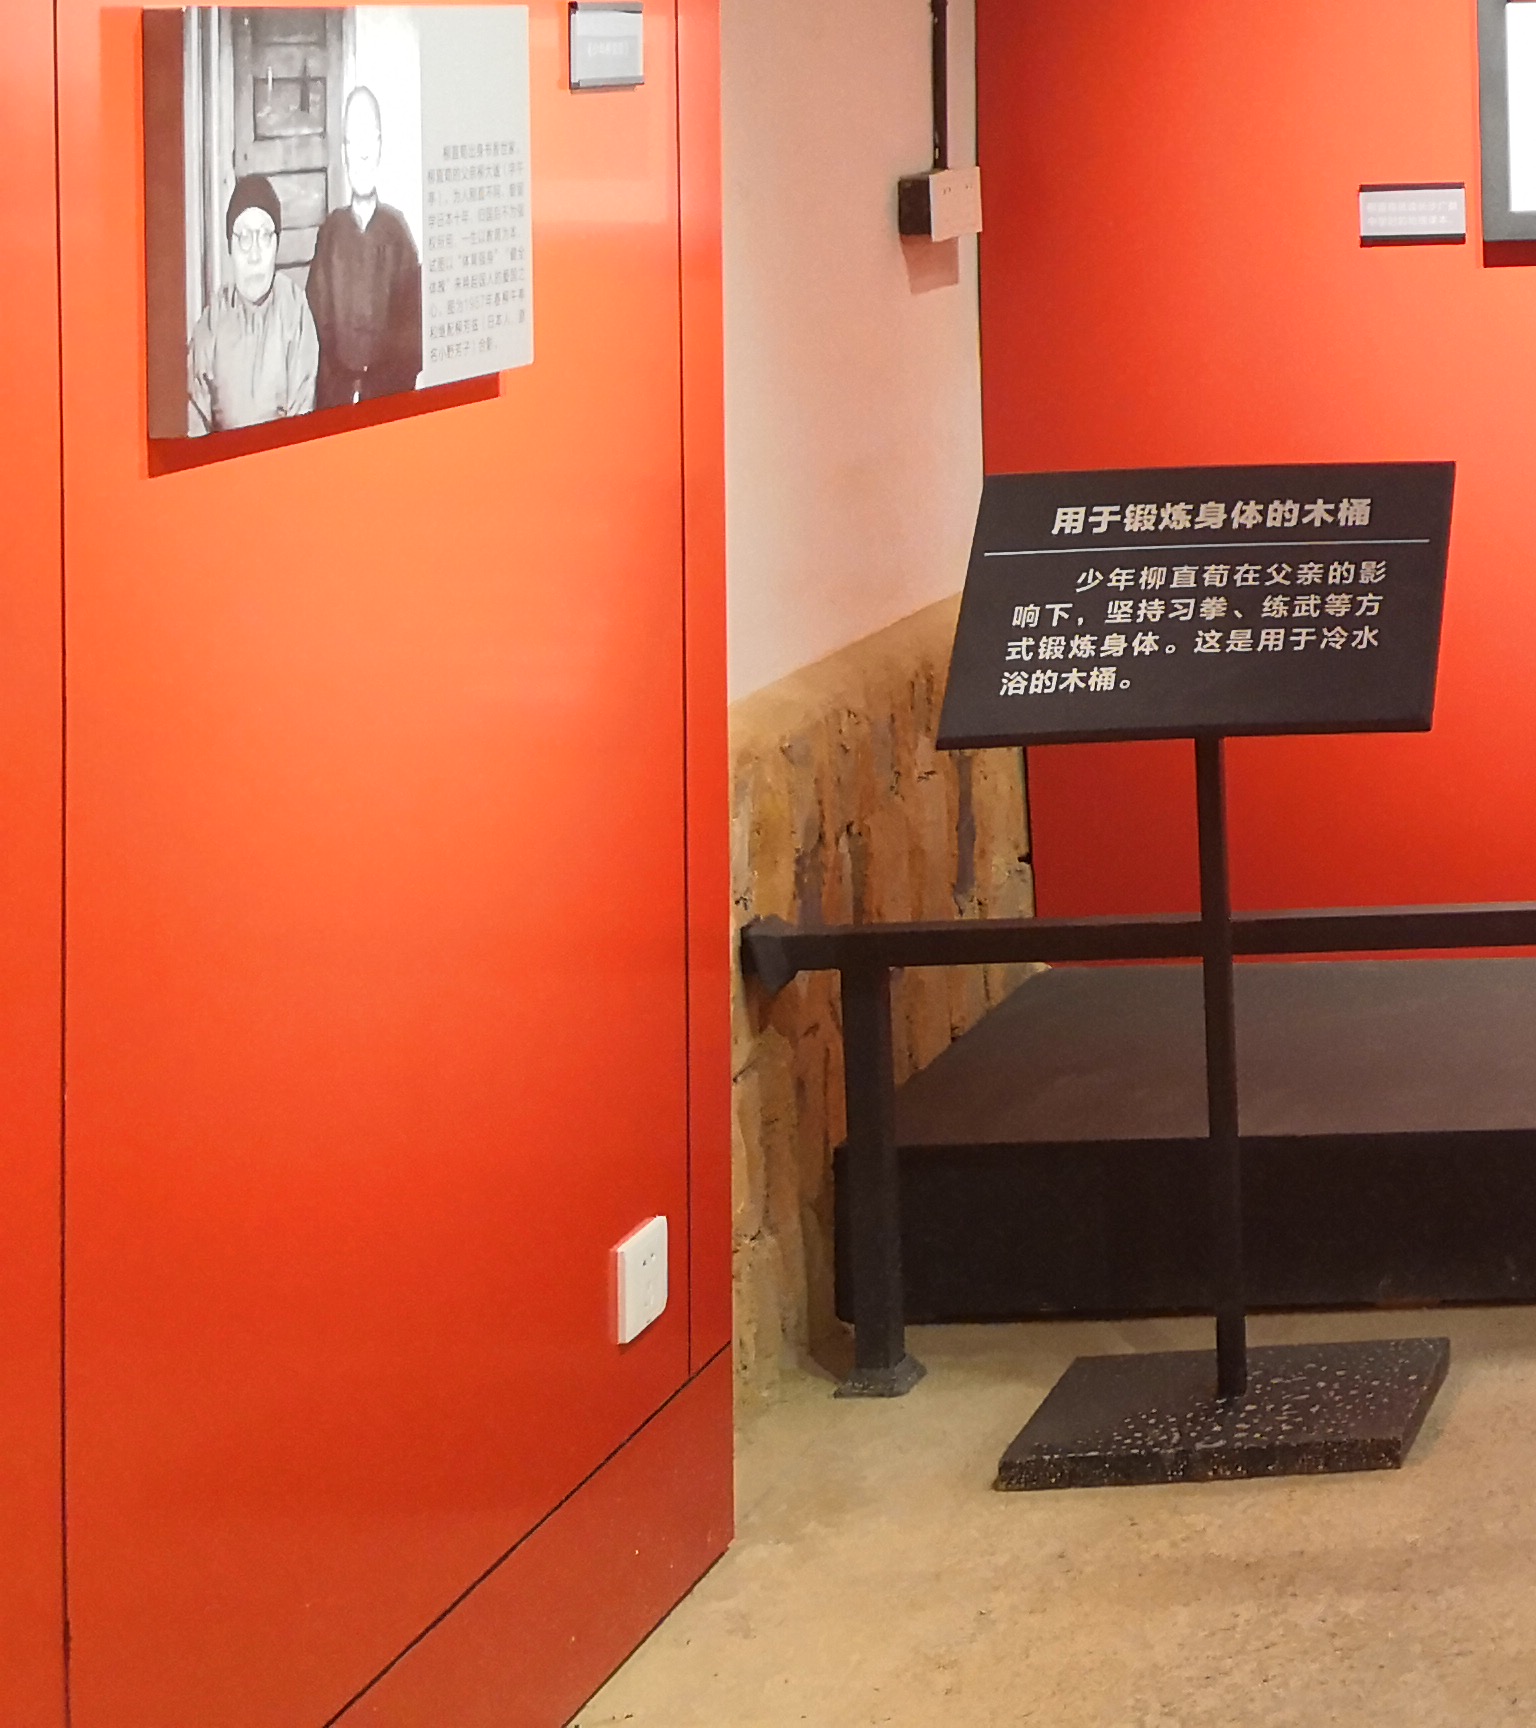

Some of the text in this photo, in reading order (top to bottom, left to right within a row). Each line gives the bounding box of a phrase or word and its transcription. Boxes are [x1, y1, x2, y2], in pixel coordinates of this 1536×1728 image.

[1052, 497, 1372, 535] 用于锻炼身体的木桶
[1076, 560, 1388, 593] 少年柳直荀在父亲的影
[1012, 593, 1383, 627] 响下，坚持习拳、练武等方
[1005, 625, 1380, 662] 式锻炼身体。这是用于冷水
[999, 666, 1134, 697] 浴的木桶。
